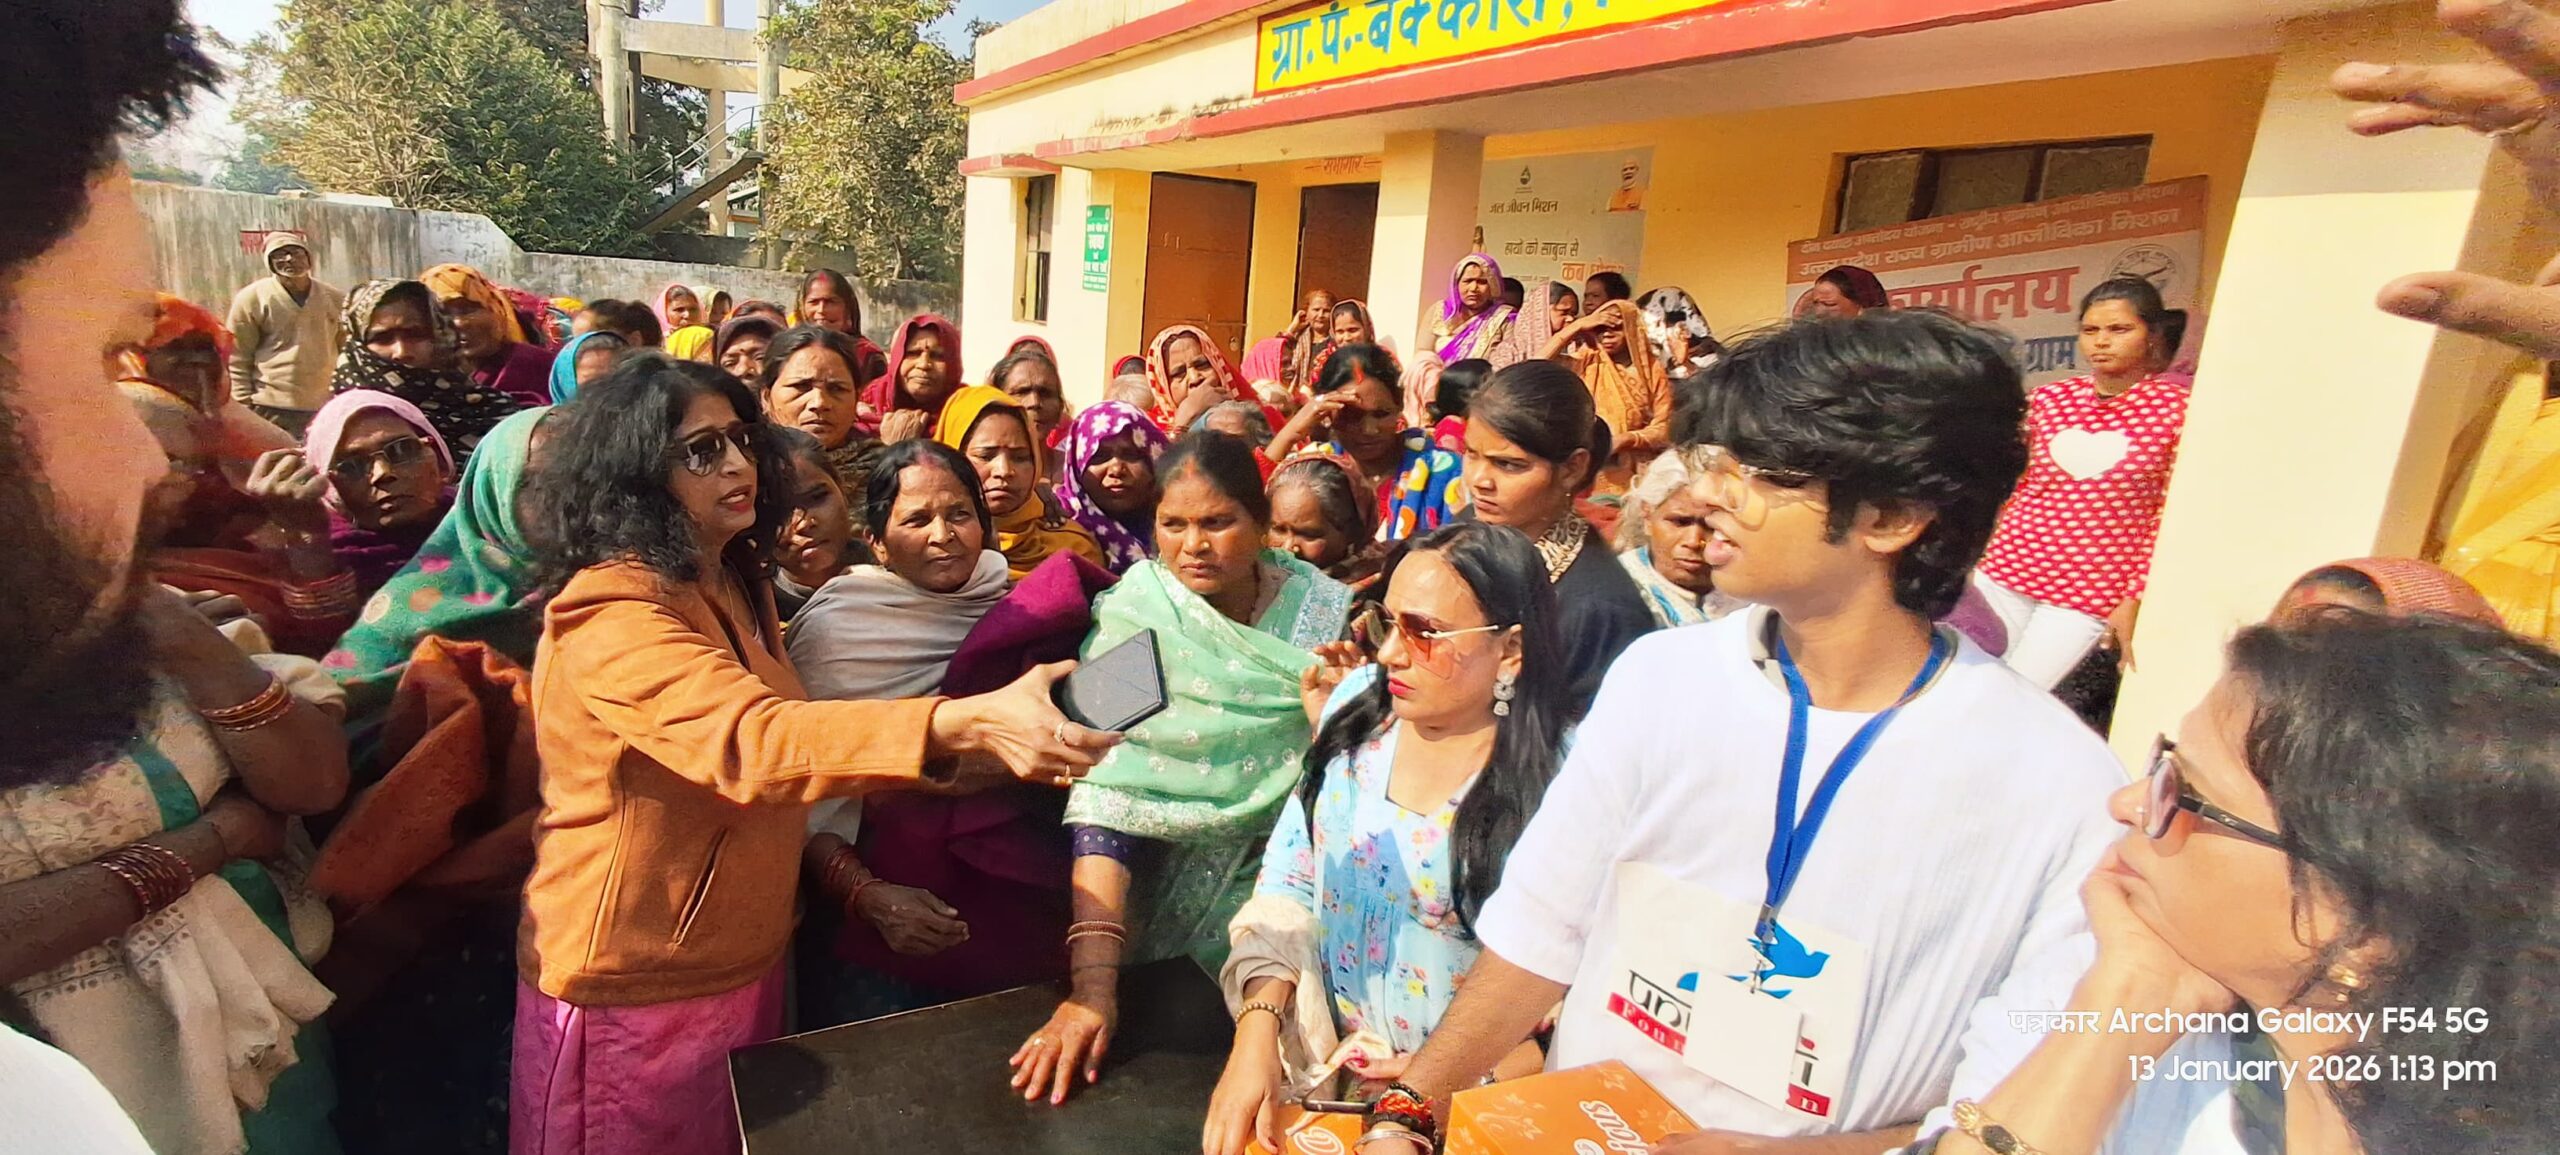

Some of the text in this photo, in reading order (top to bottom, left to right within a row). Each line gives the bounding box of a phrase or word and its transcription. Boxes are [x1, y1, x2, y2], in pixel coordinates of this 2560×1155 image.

[1531, 197, 1559, 213] मिशन
[1885, 247, 1926, 264] राज्य
[1930, 234, 1993, 260] ग्रामीण
[1997, 218, 2104, 248] आजीविका
[2107, 208, 2181, 232] मिशन
[1541, 242, 1567, 261] साबुन
[1569, 238, 1580, 257] से
[1562, 262, 1586, 282] कब
